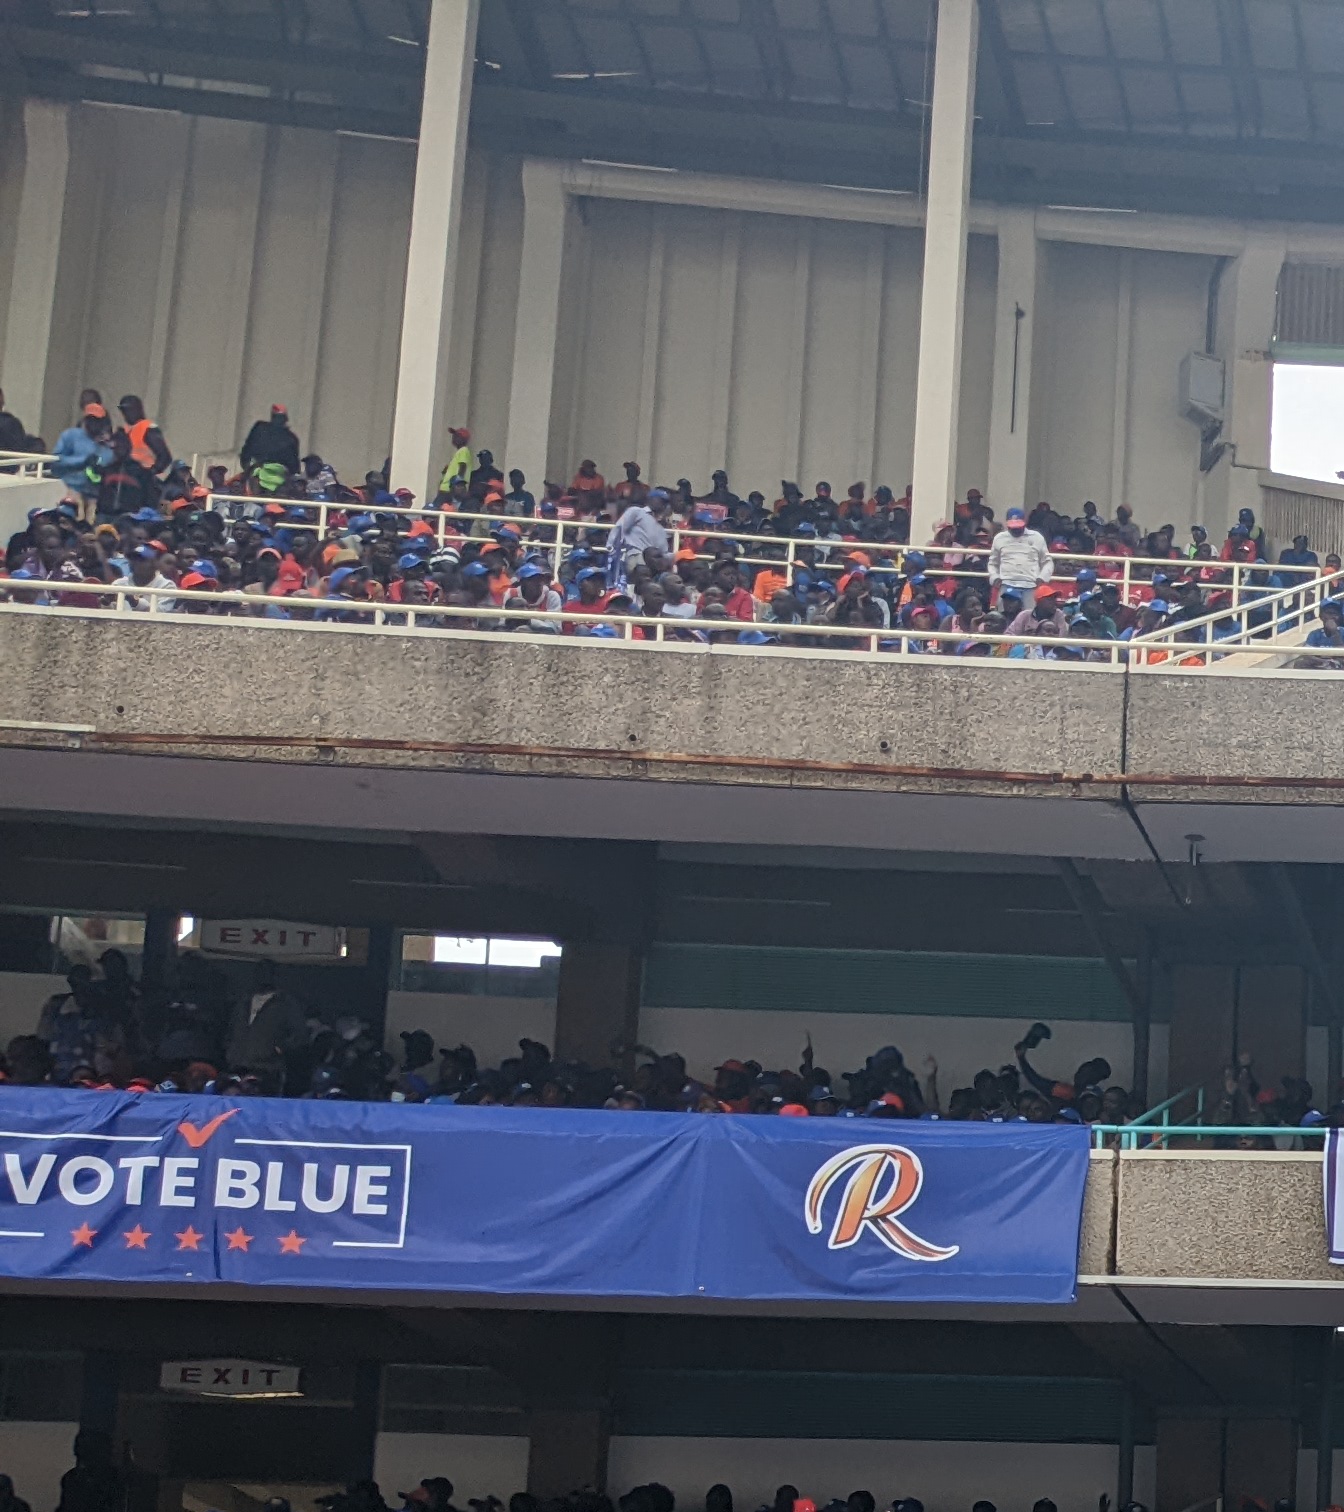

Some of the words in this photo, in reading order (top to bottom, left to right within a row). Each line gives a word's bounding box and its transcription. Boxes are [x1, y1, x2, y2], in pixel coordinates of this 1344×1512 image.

[219, 926, 318, 948] EXIT
[4, 1153, 200, 1207] VOTE
[213, 1158, 392, 1215] BLUE
[179, 1366, 281, 1387] EXIT
